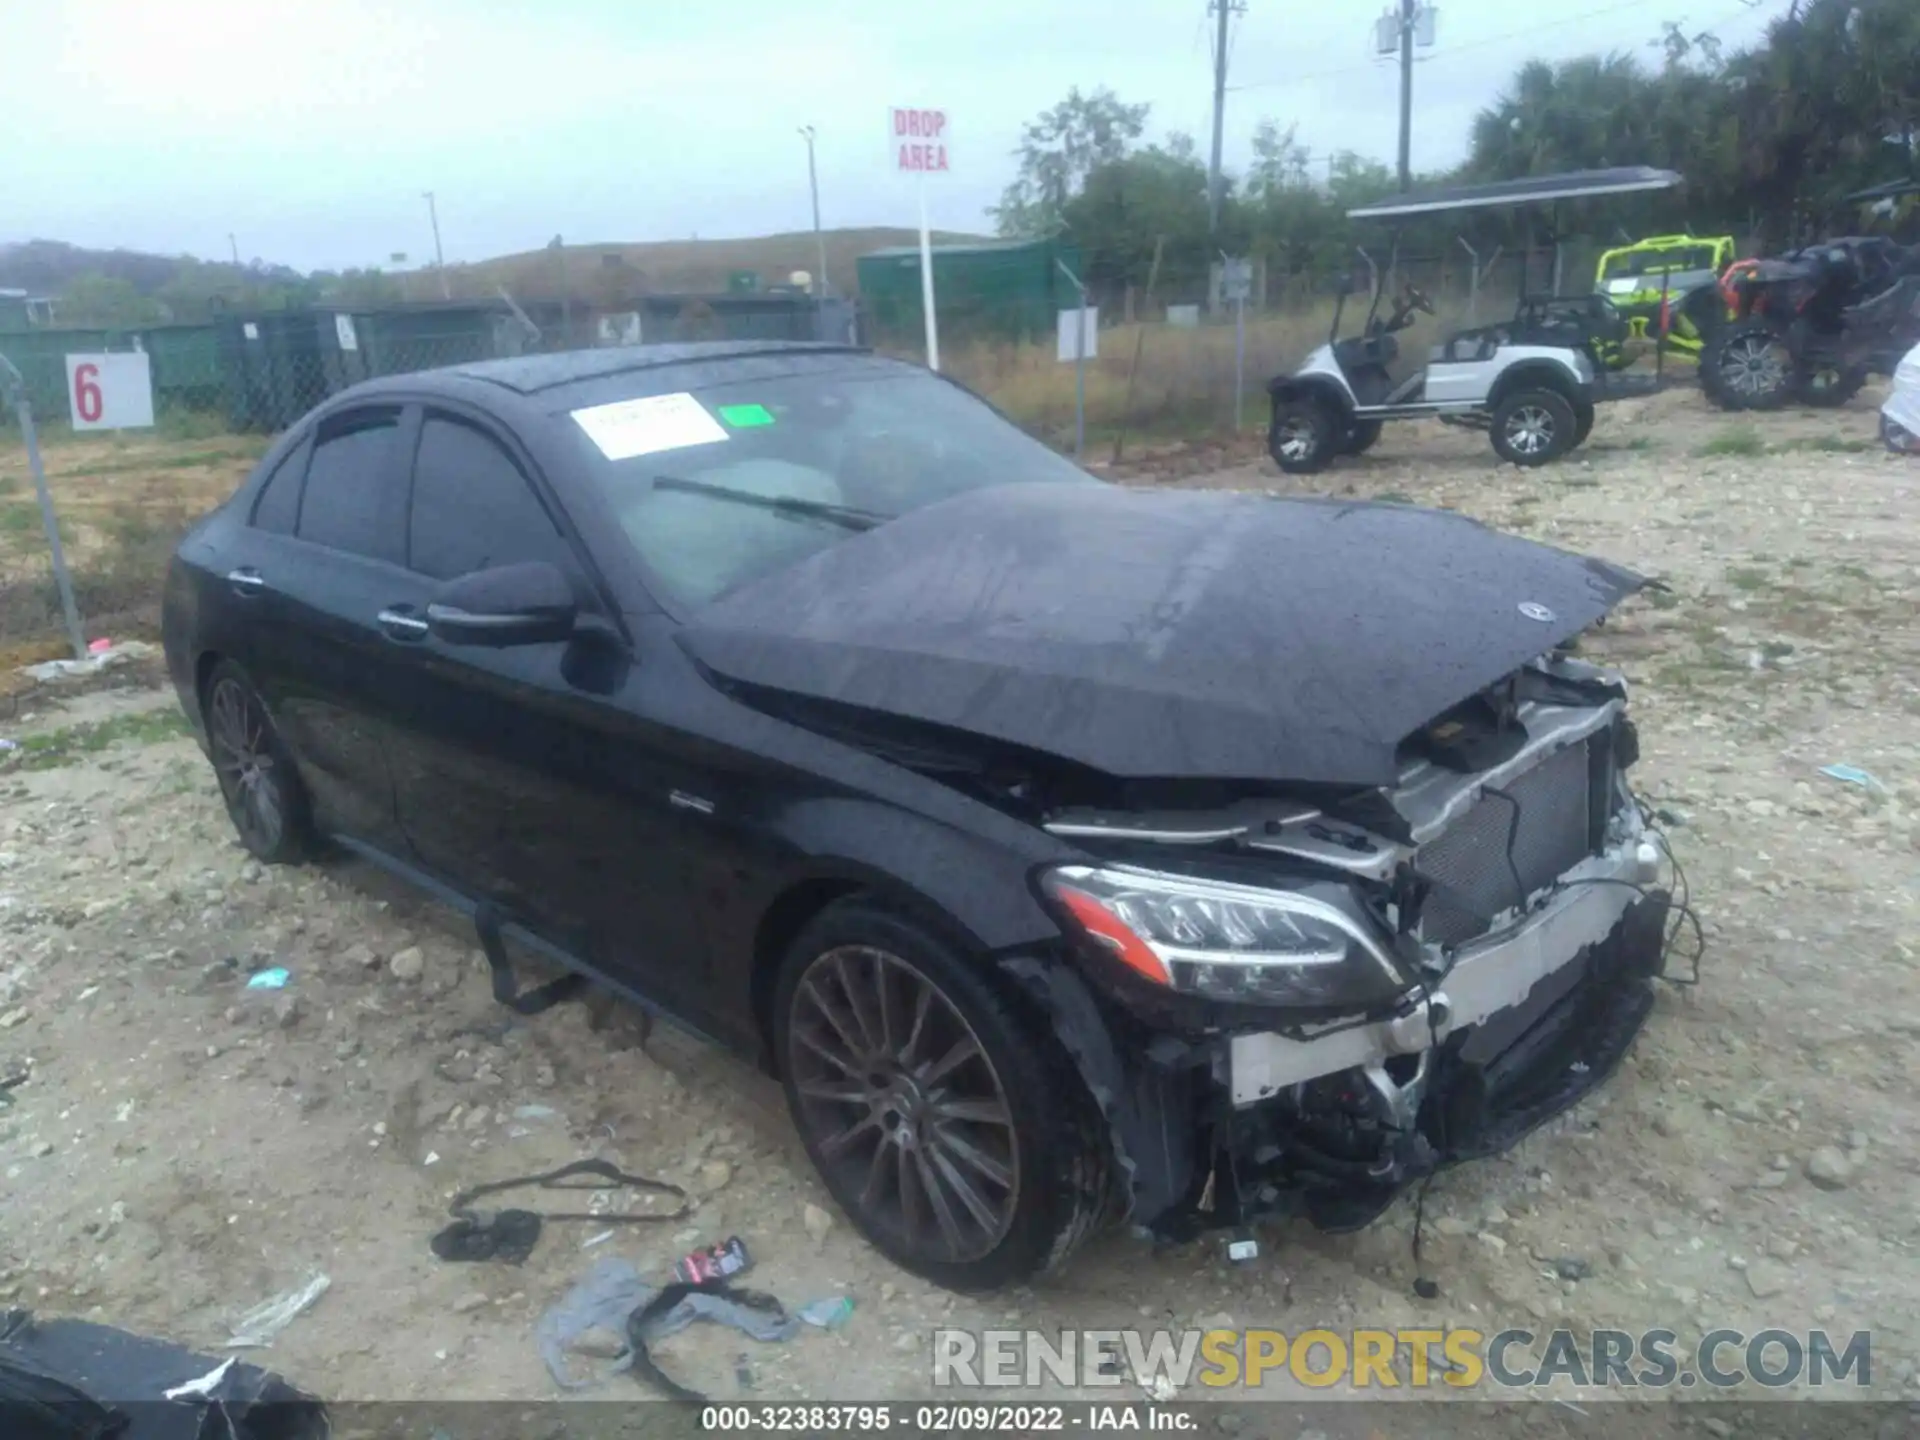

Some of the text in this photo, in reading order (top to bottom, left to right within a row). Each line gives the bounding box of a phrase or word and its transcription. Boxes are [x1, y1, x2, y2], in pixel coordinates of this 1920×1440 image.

[894, 110, 945, 137] DROP
[899, 144, 949, 171] AREA
[75, 363, 102, 422] 6
